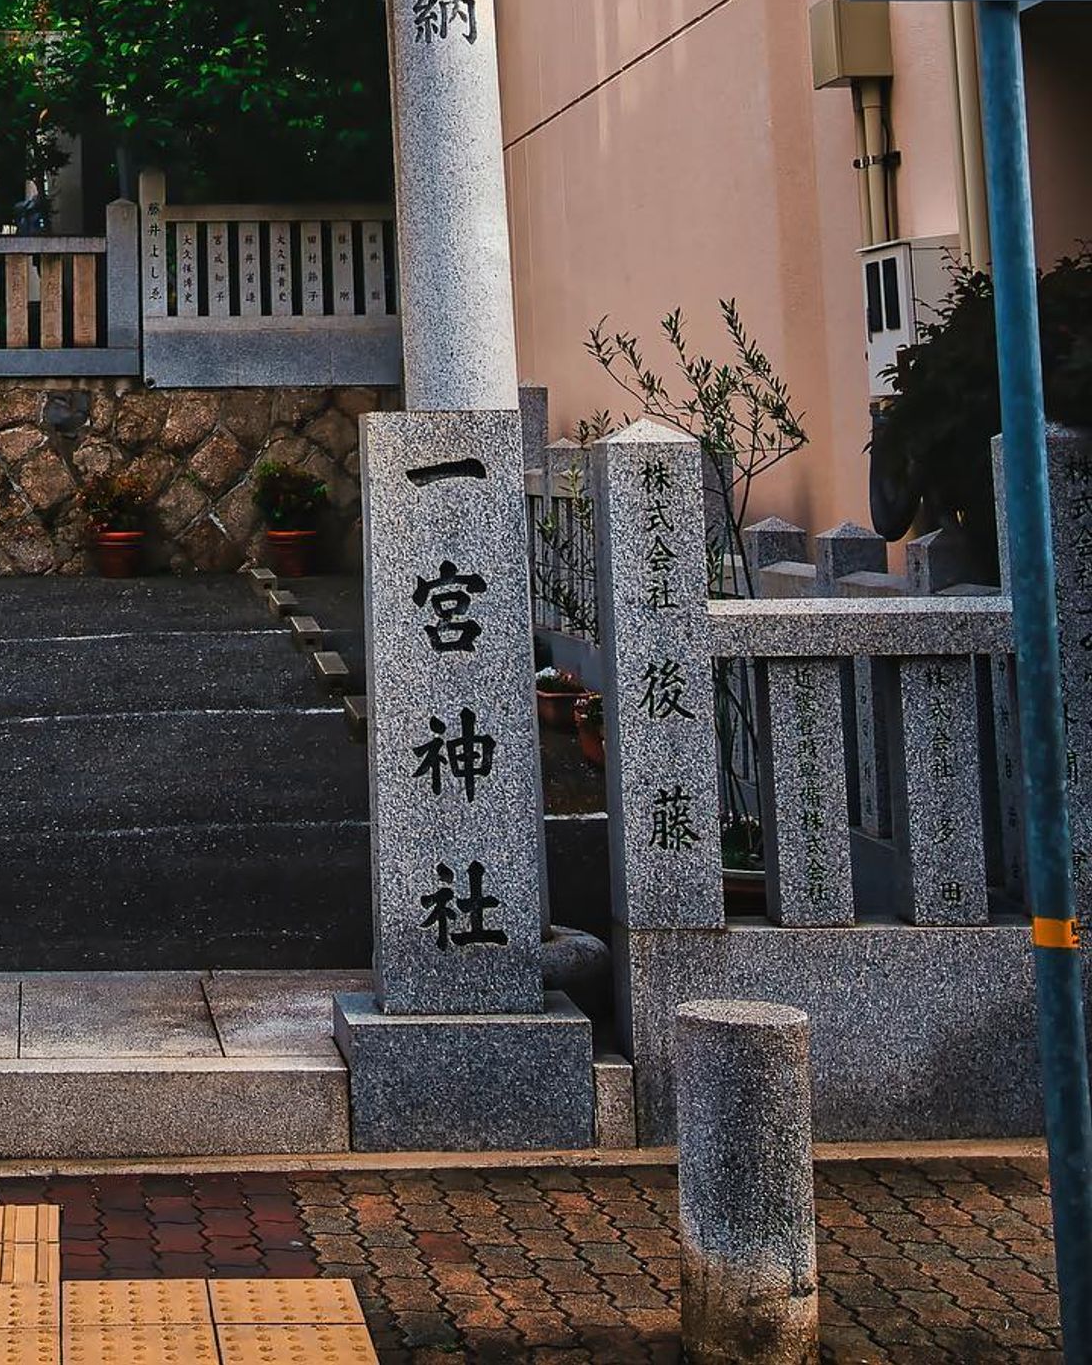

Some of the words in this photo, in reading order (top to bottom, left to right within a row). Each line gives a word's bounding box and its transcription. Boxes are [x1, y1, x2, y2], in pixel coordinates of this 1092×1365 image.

[406, 455, 510, 952] 一宮神社
[636, 458, 702, 854] 株式会社後藤
